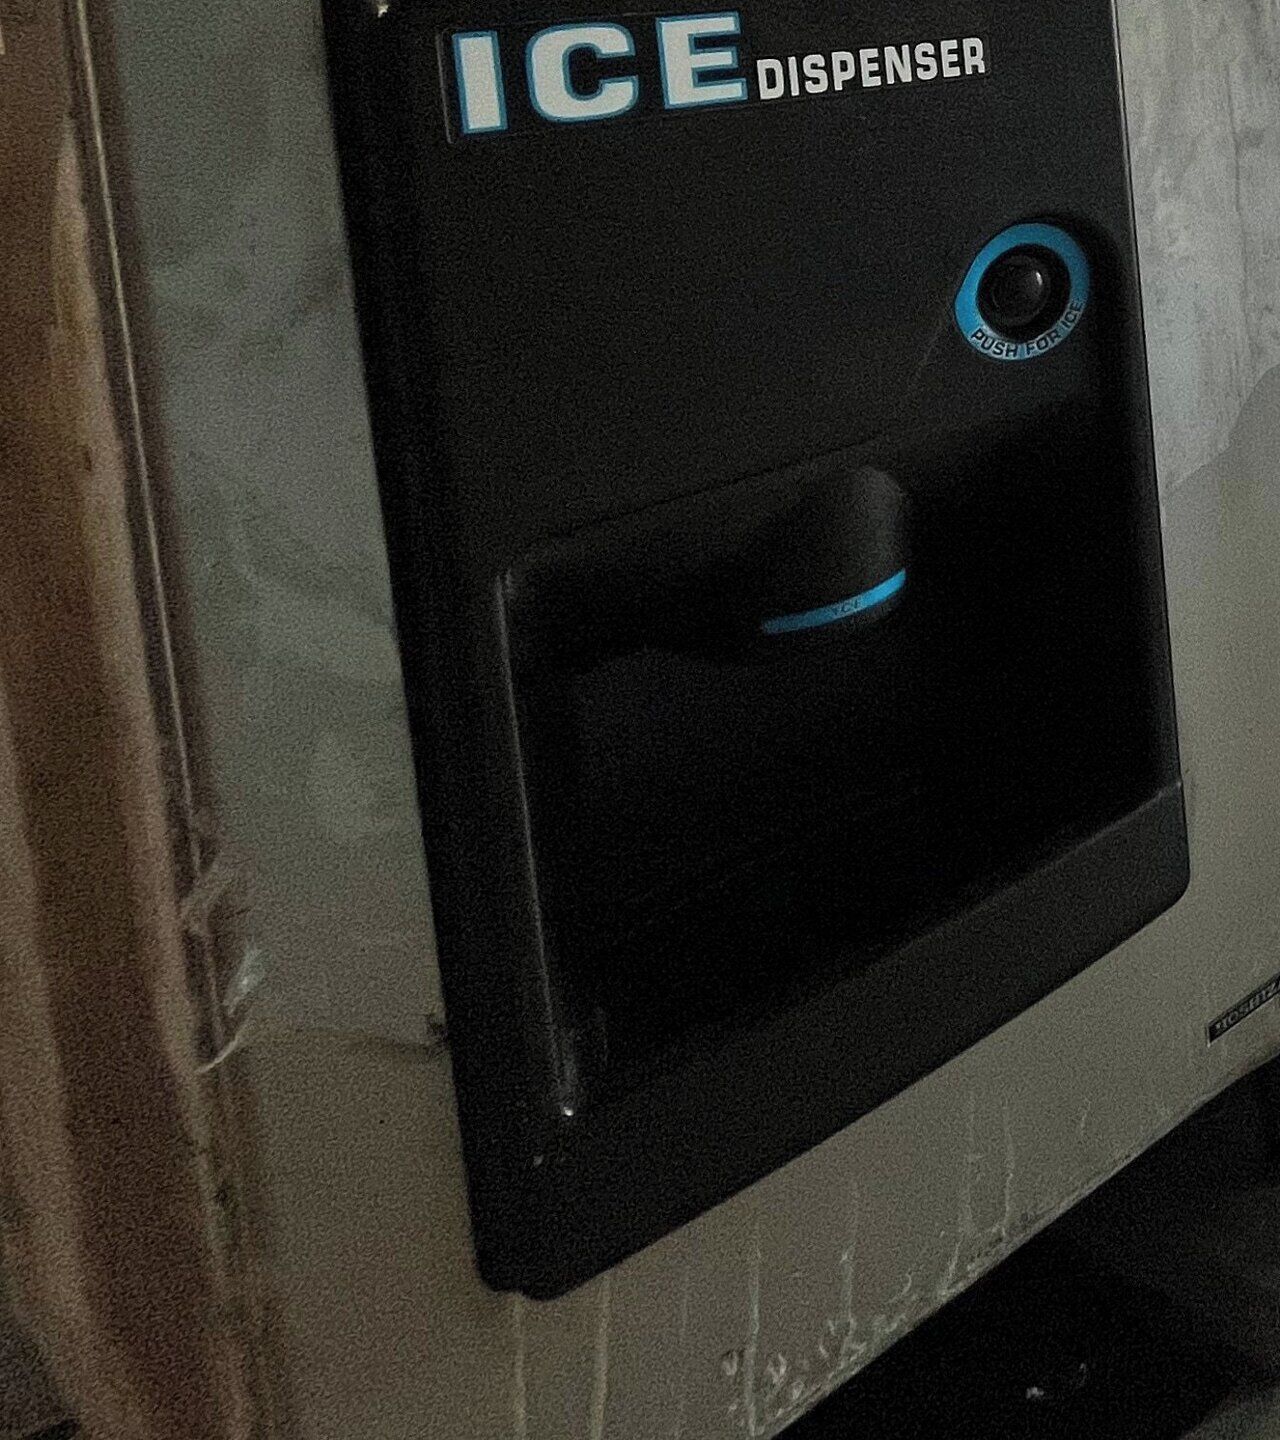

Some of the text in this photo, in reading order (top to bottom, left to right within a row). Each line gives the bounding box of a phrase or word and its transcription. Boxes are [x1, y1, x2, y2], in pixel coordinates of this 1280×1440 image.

[451, 10, 987, 136] ICE DISPENSER
[970, 301, 1083, 358] PUSH FOR ICE
